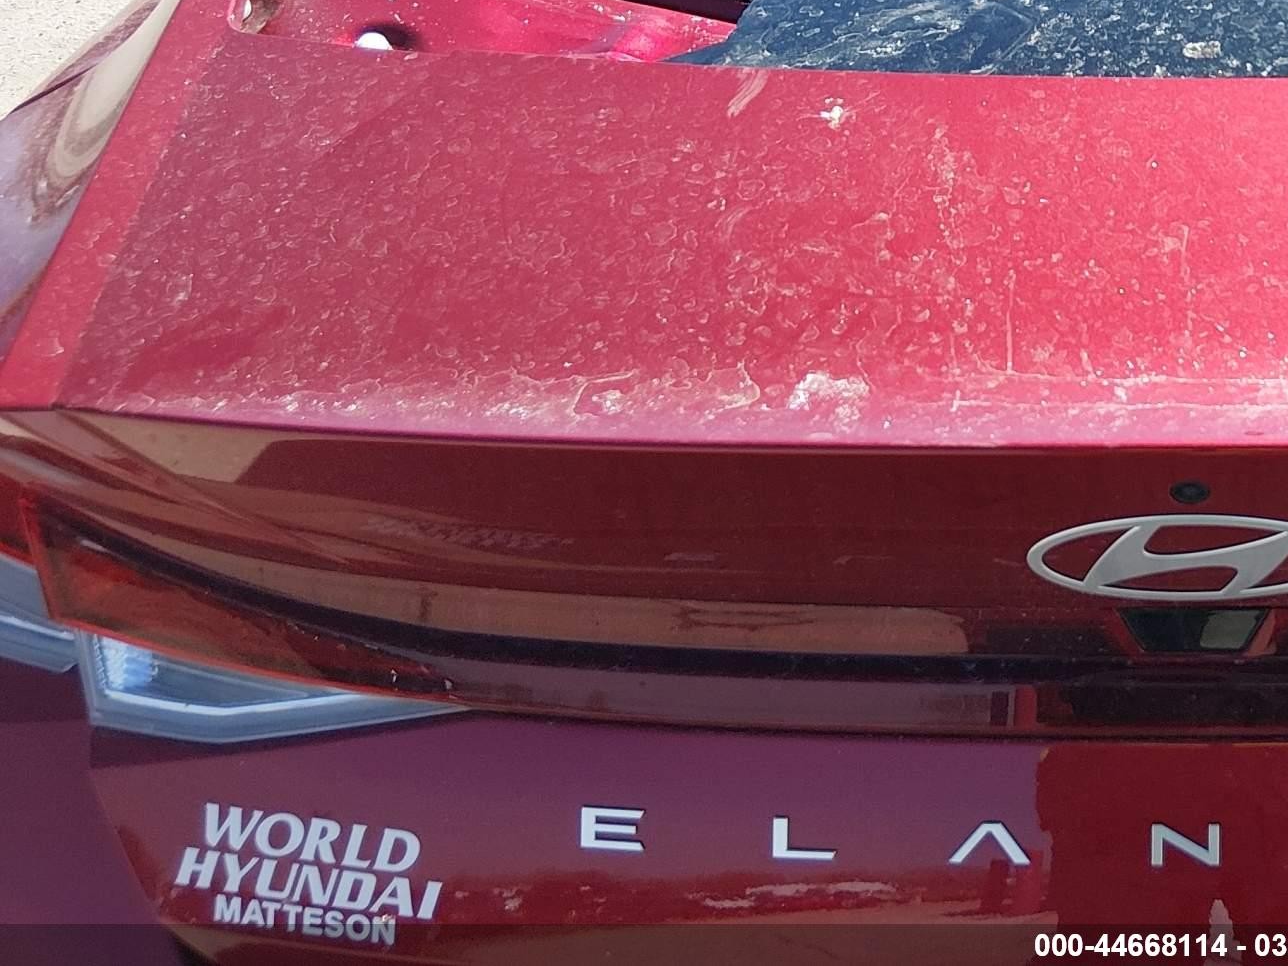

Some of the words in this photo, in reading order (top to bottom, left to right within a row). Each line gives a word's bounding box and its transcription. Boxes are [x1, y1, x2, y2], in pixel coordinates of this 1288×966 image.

[204, 802, 421, 873] WORLD
[174, 846, 443, 920] HYUNDAI
[213, 893, 396, 945] MATTESON
